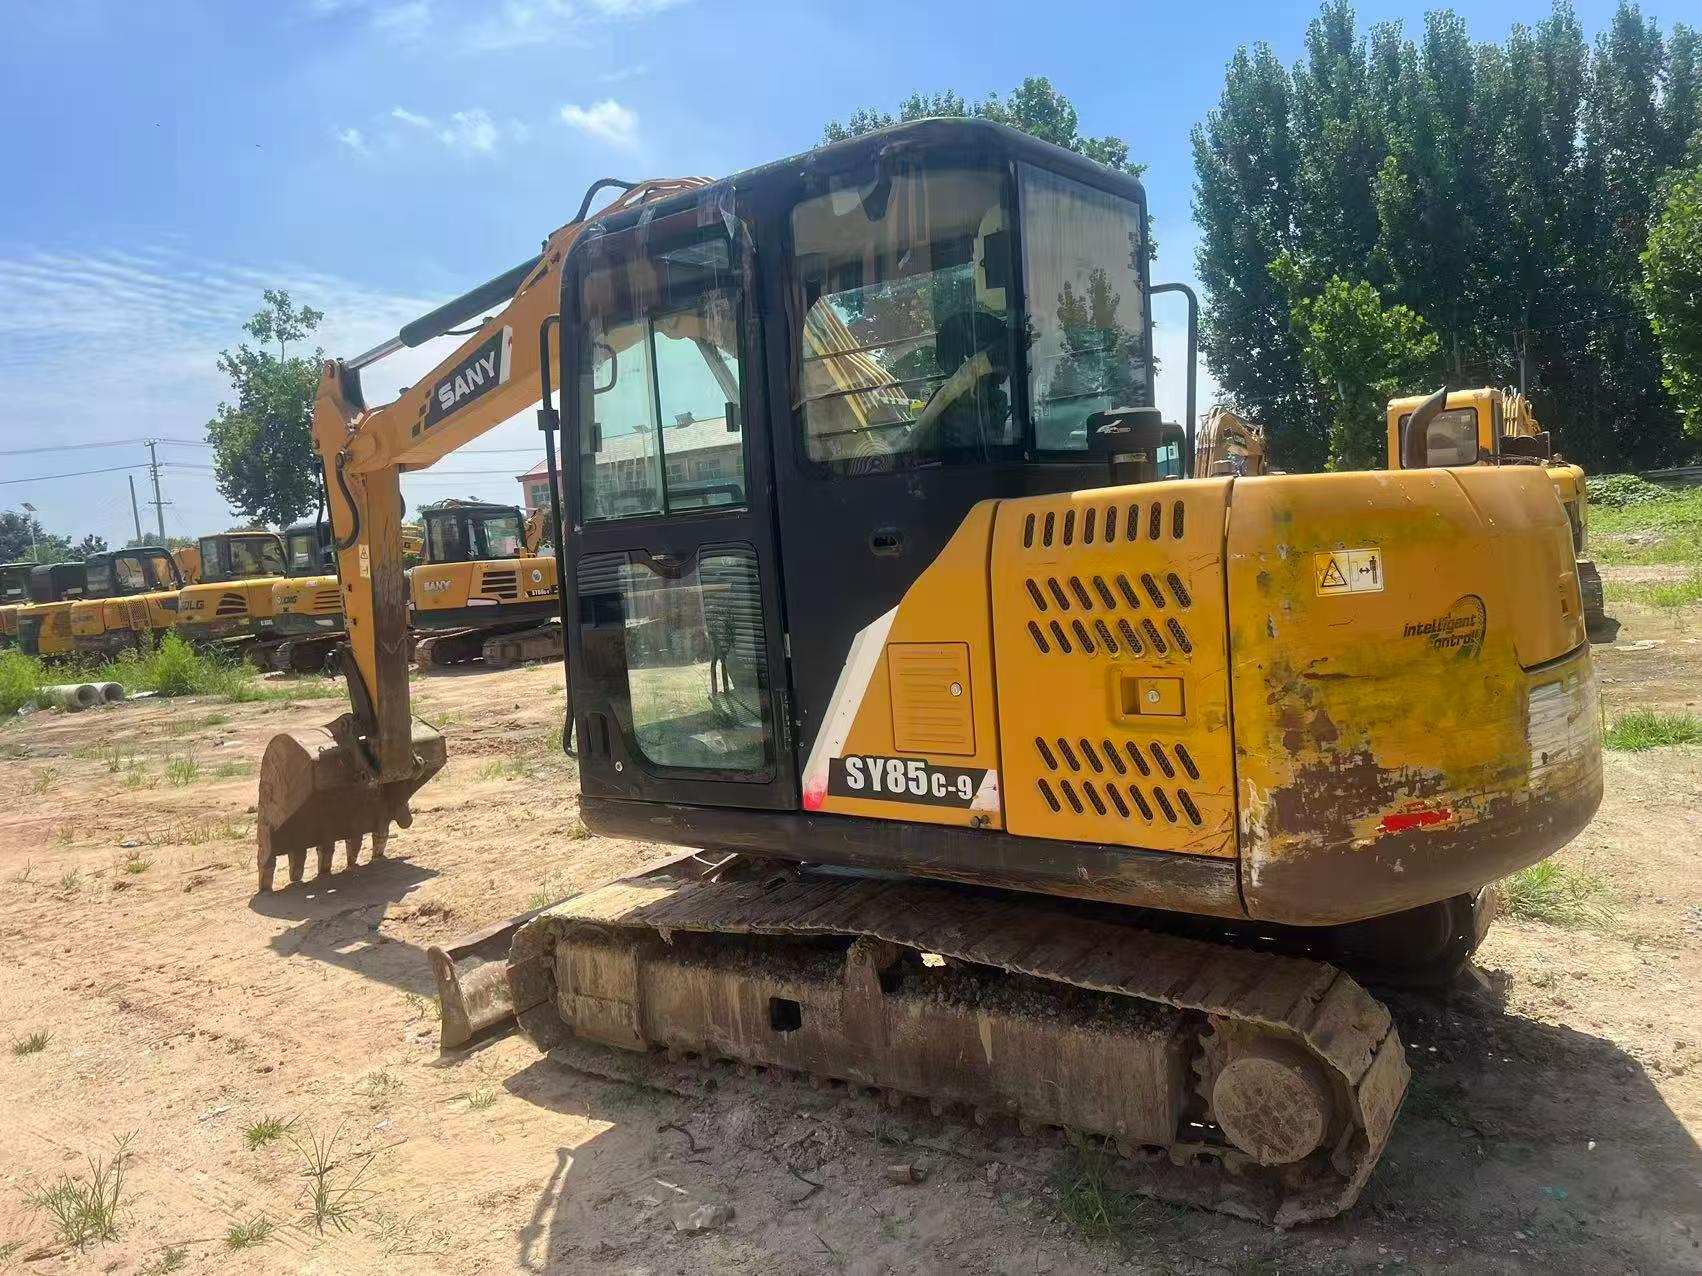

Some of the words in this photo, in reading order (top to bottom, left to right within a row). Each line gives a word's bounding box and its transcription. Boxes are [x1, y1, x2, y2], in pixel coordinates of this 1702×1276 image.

[438, 351, 496, 411] SANY
[424, 580, 451, 592] SANY
[1430, 630, 1478, 649] ontrol
